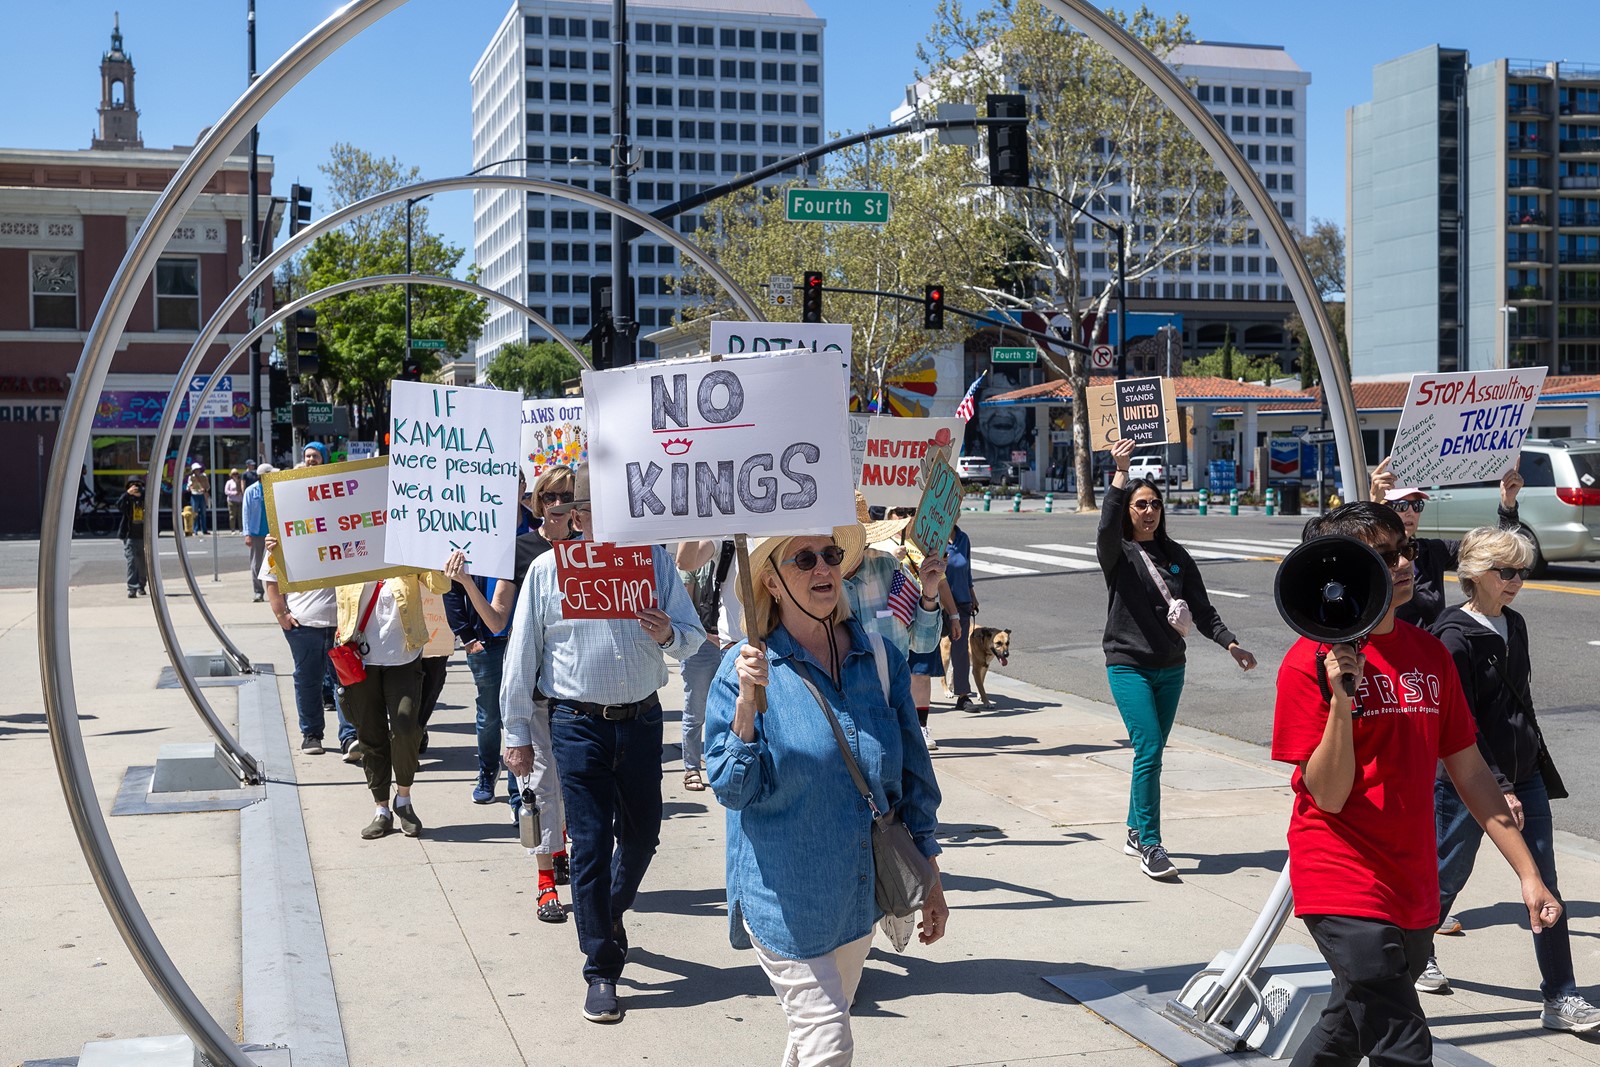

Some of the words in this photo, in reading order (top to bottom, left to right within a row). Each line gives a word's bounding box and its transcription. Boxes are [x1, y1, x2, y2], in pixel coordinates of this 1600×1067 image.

[793, 197, 852, 214] Fourth
[864, 198, 883, 215] St
[995, 351, 1021, 359] Fourth
[1025, 351, 1034, 359] St
[650, 369, 745, 430] NO
[1121, 385, 1135, 393] BAY
[1136, 384, 1156, 392] AREA
[1125, 393, 1154, 402] STANDS
[1416, 380, 1464, 406] STOP
[433, 389, 458, 418] IF
[521, 407, 555, 424] LAWS
[559, 406, 583, 421] OUT
[1123, 403, 1159, 421] UNITED
[1126, 422, 1159, 431] AGAINST
[1400, 413, 1435, 440] Science
[1459, 403, 1525, 432] TRUTH
[393, 417, 495, 454] KAMALA
[1134, 432, 1153, 440] HATE
[1271, 440, 1299, 448] Chevron
[1394, 422, 1437, 456] Immigrants
[1440, 428, 1527, 457] DEMOCRACY
[867, 439, 929, 459] NEUTER
[1391, 454, 1408, 470] Rule
[1410, 447, 1417, 456] of
[1417, 436, 1433, 450] Law
[1396, 443, 1439, 478] niversities
[392, 453, 437, 470] were
[445, 458, 518, 480] president
[862, 463, 921, 487] MUSK
[1403, 458, 1432, 487] Medical
[1415, 457, 1445, 485] Research
[1430, 465, 1452, 483] Free
[1443, 458, 1468, 481] Speech
[1458, 460, 1478, 479] Courts
[1472, 454, 1496, 479] Federal
[1479, 457, 1502, 480] Govern
[1492, 455, 1510, 474] ment
[307, 479, 359, 502] KEEP
[625, 441, 821, 518] KINGS
[930, 462, 948, 499] DO
[943, 480, 962, 521] NOT
[441, 483, 466, 504] all
[480, 485, 503, 505] be
[284, 517, 328, 537] FREE
[390, 504, 408, 521] at
[416, 508, 498, 536] BRUNCH!
[317, 540, 368, 562] FREE
[558, 542, 607, 569] ICE
[612, 553, 624, 567] is
[632, 551, 652, 567] the
[564, 577, 653, 613] GESTAPO
